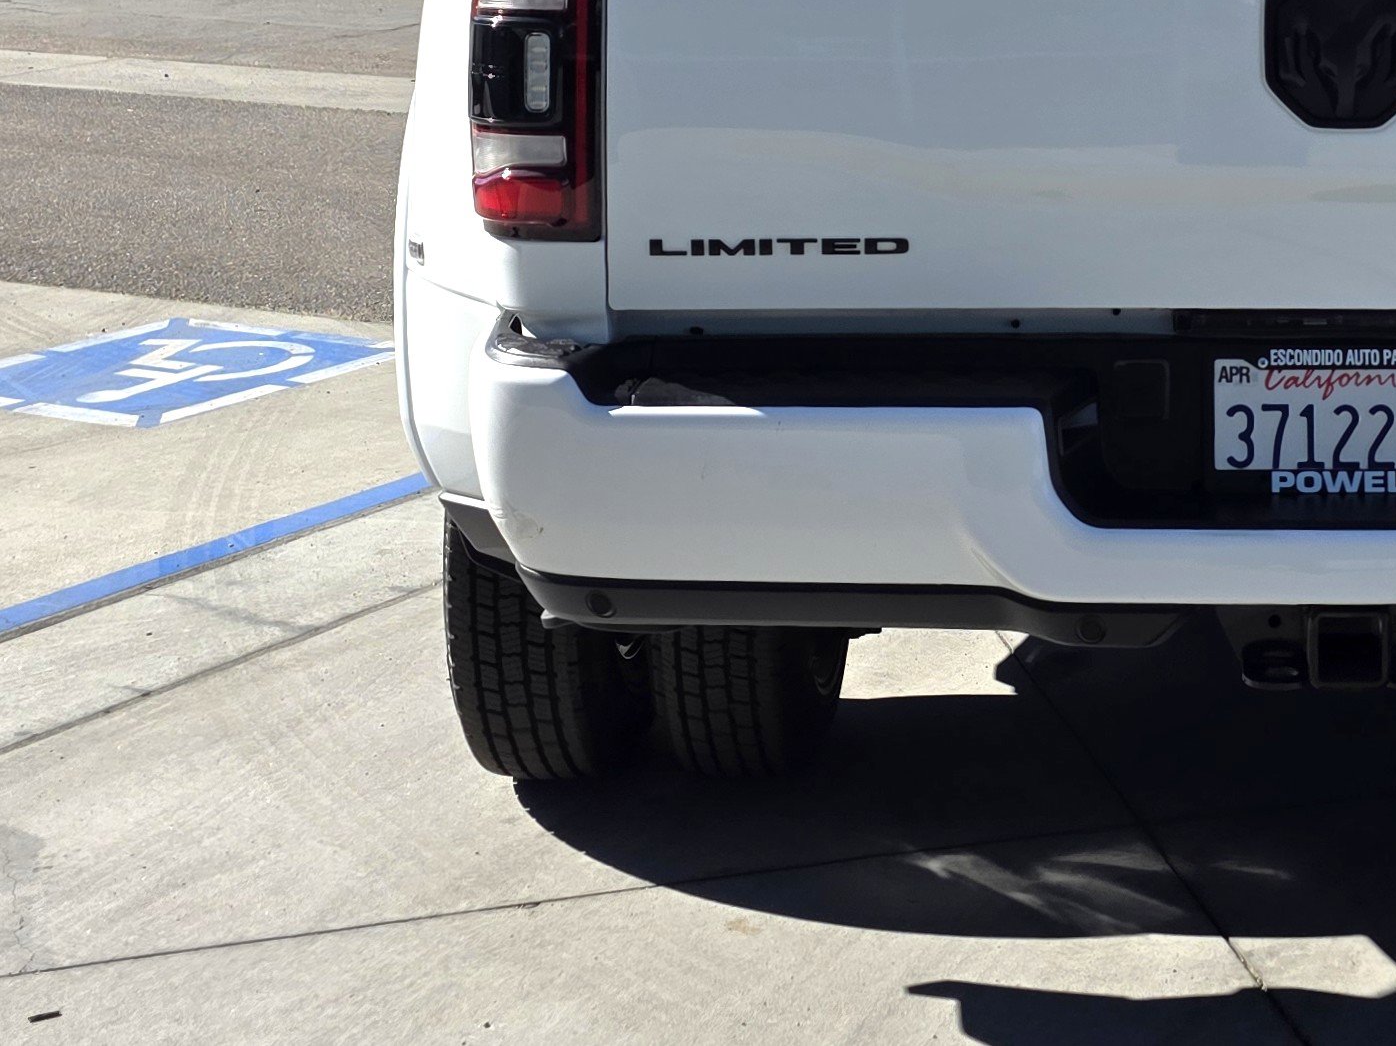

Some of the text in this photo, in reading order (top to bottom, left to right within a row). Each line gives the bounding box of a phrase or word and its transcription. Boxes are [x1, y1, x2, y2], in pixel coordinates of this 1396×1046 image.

[649, 238, 910, 256] LIMITED
[1269, 349, 1343, 366] ESCONDIDO
[1345, 349, 1380, 366] AUTO
[1218, 365, 1250, 384] APR
